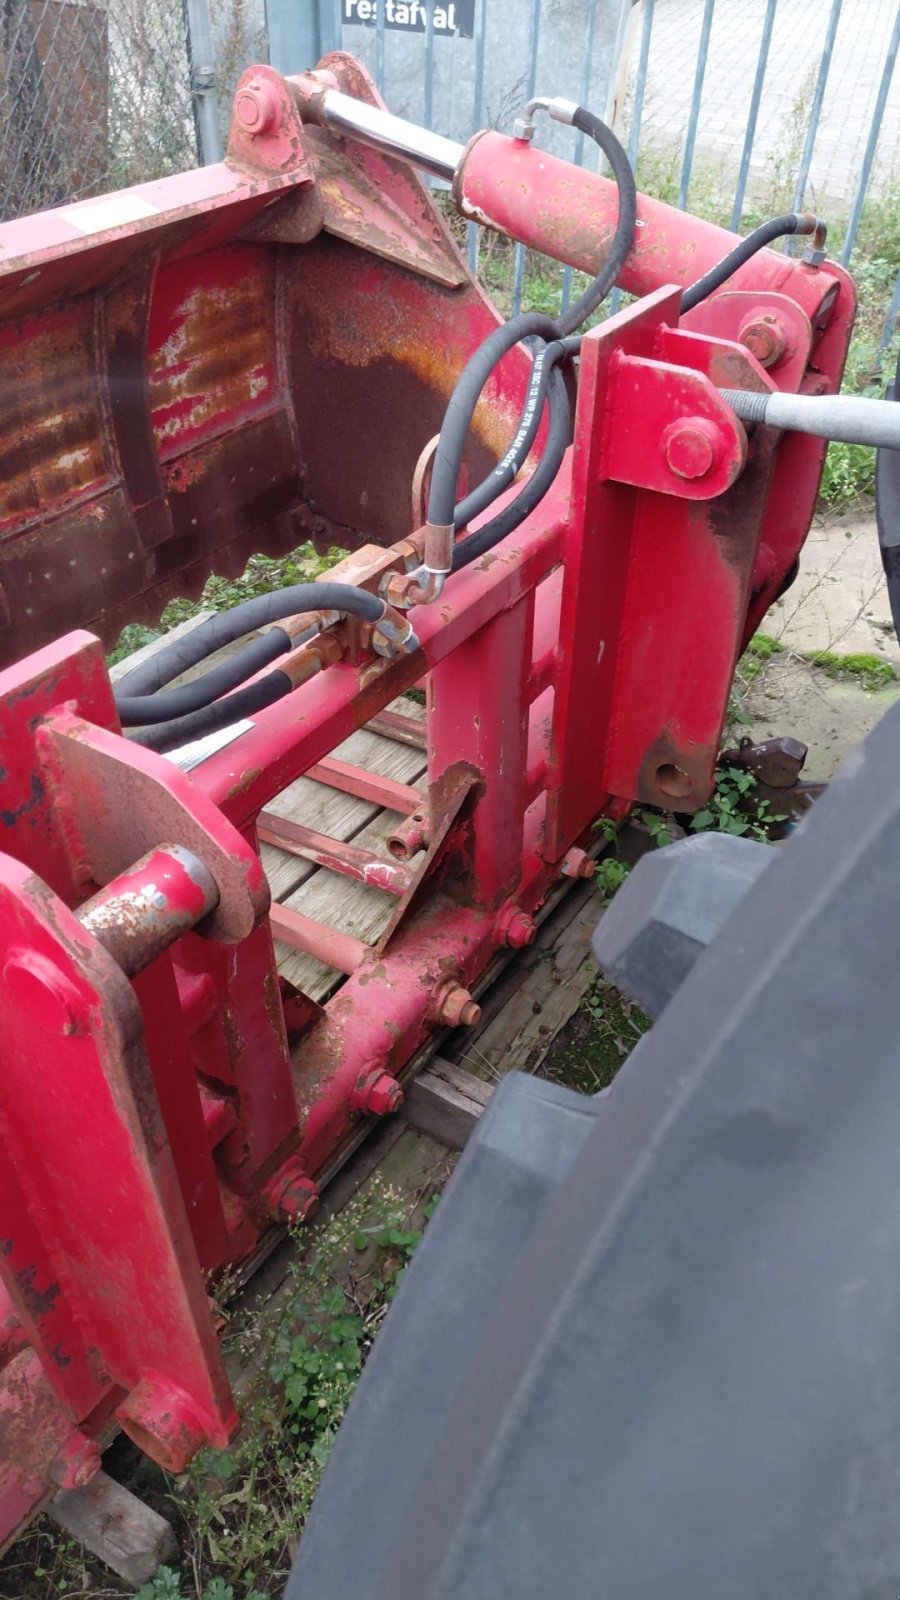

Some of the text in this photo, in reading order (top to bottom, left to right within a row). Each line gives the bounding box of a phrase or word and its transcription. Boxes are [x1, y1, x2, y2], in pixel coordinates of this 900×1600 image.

[529, 387, 539, 397] 12
[526, 398, 537, 412] WP
[512, 430, 527, 448] BAR
